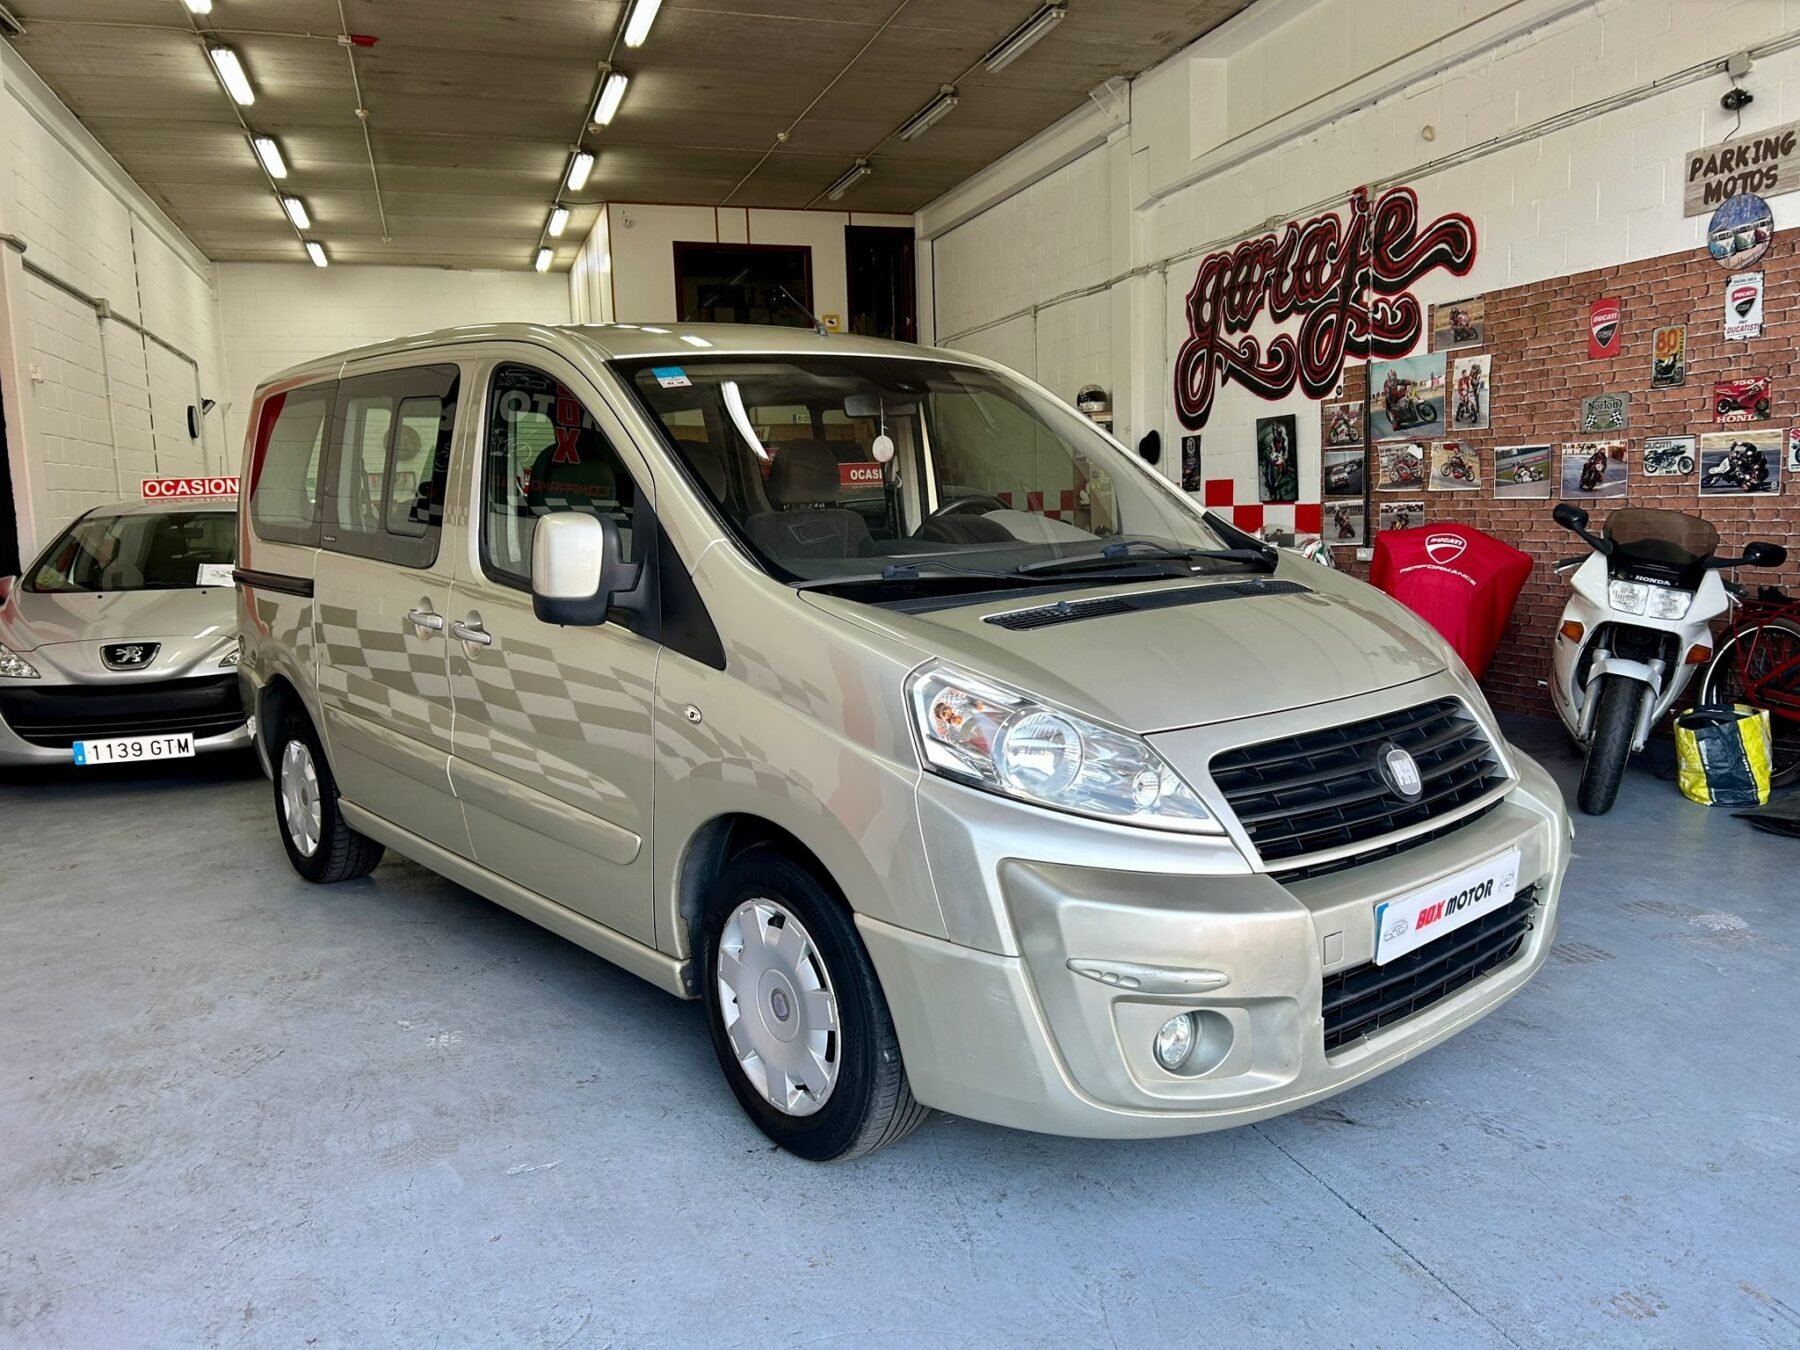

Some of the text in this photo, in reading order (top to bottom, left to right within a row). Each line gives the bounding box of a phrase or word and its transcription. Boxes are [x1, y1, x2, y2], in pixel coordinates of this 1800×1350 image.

[1689, 130, 1797, 182] PARKING
[1703, 164, 1778, 205] MOTOS
[1593, 312, 1618, 322] DUCATI
[1587, 399, 1622, 411] Norton
[850, 468, 883, 481] OCASI
[144, 478, 240, 496] OCASION
[1430, 537, 1463, 546] DUCATI
[1634, 575, 1671, 586] HONDA
[92, 738, 189, 760] 1139 GTM
[1415, 879, 1494, 931] BOX MOTOR
